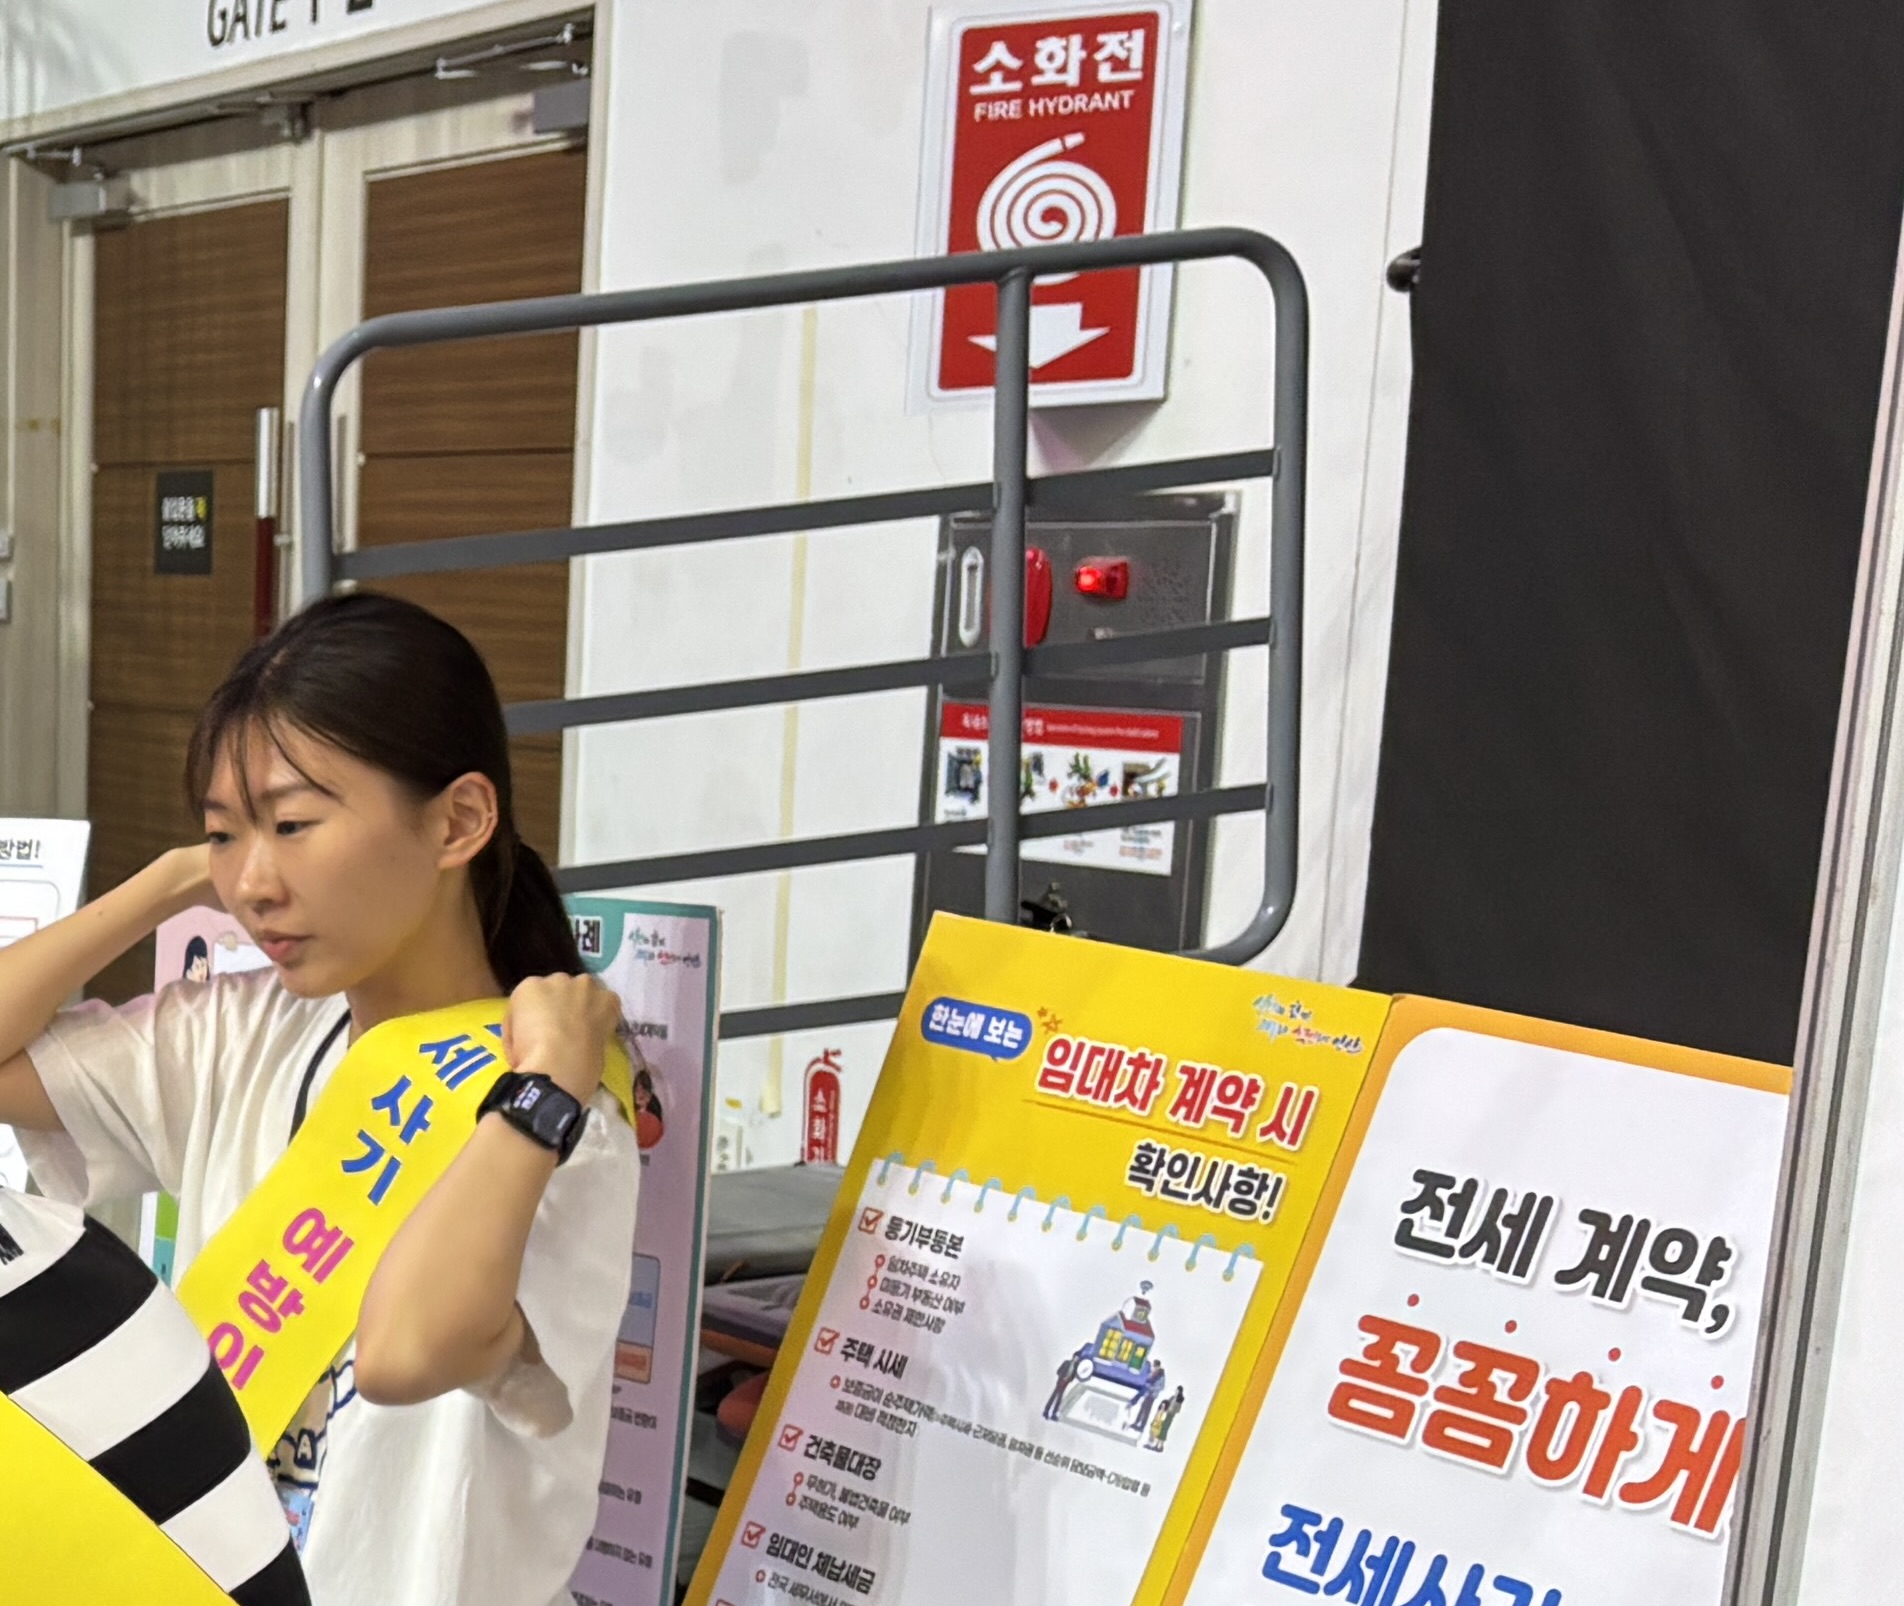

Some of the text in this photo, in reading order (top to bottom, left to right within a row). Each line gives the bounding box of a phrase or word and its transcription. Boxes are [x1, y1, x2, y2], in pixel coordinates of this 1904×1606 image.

[969, 28, 1145, 95] 소화전
[974, 90, 1135, 122] FIRE HYDRANT
[929, 1003, 1024, 1049] 한눈에 보는
[342, 1028, 500, 1206] 세사기
[1038, 1038, 1316, 1145] 임대차 계약 시
[1129, 1143, 1282, 1220] 확인사항!
[884, 1215, 965, 1260] 등기부등본
[1393, 1168, 1733, 1335] 전세 계약,
[208, 1207, 356, 1390] 예방이
[928, 1269, 961, 1291] 소유자
[840, 1337, 909, 1380] 주택 시세
[1328, 1314, 1747, 1534] 꼼꼼하게
[804, 1435, 882, 1481] 건축물대장
[766, 1533, 875, 1595] 임대인 체납세금
